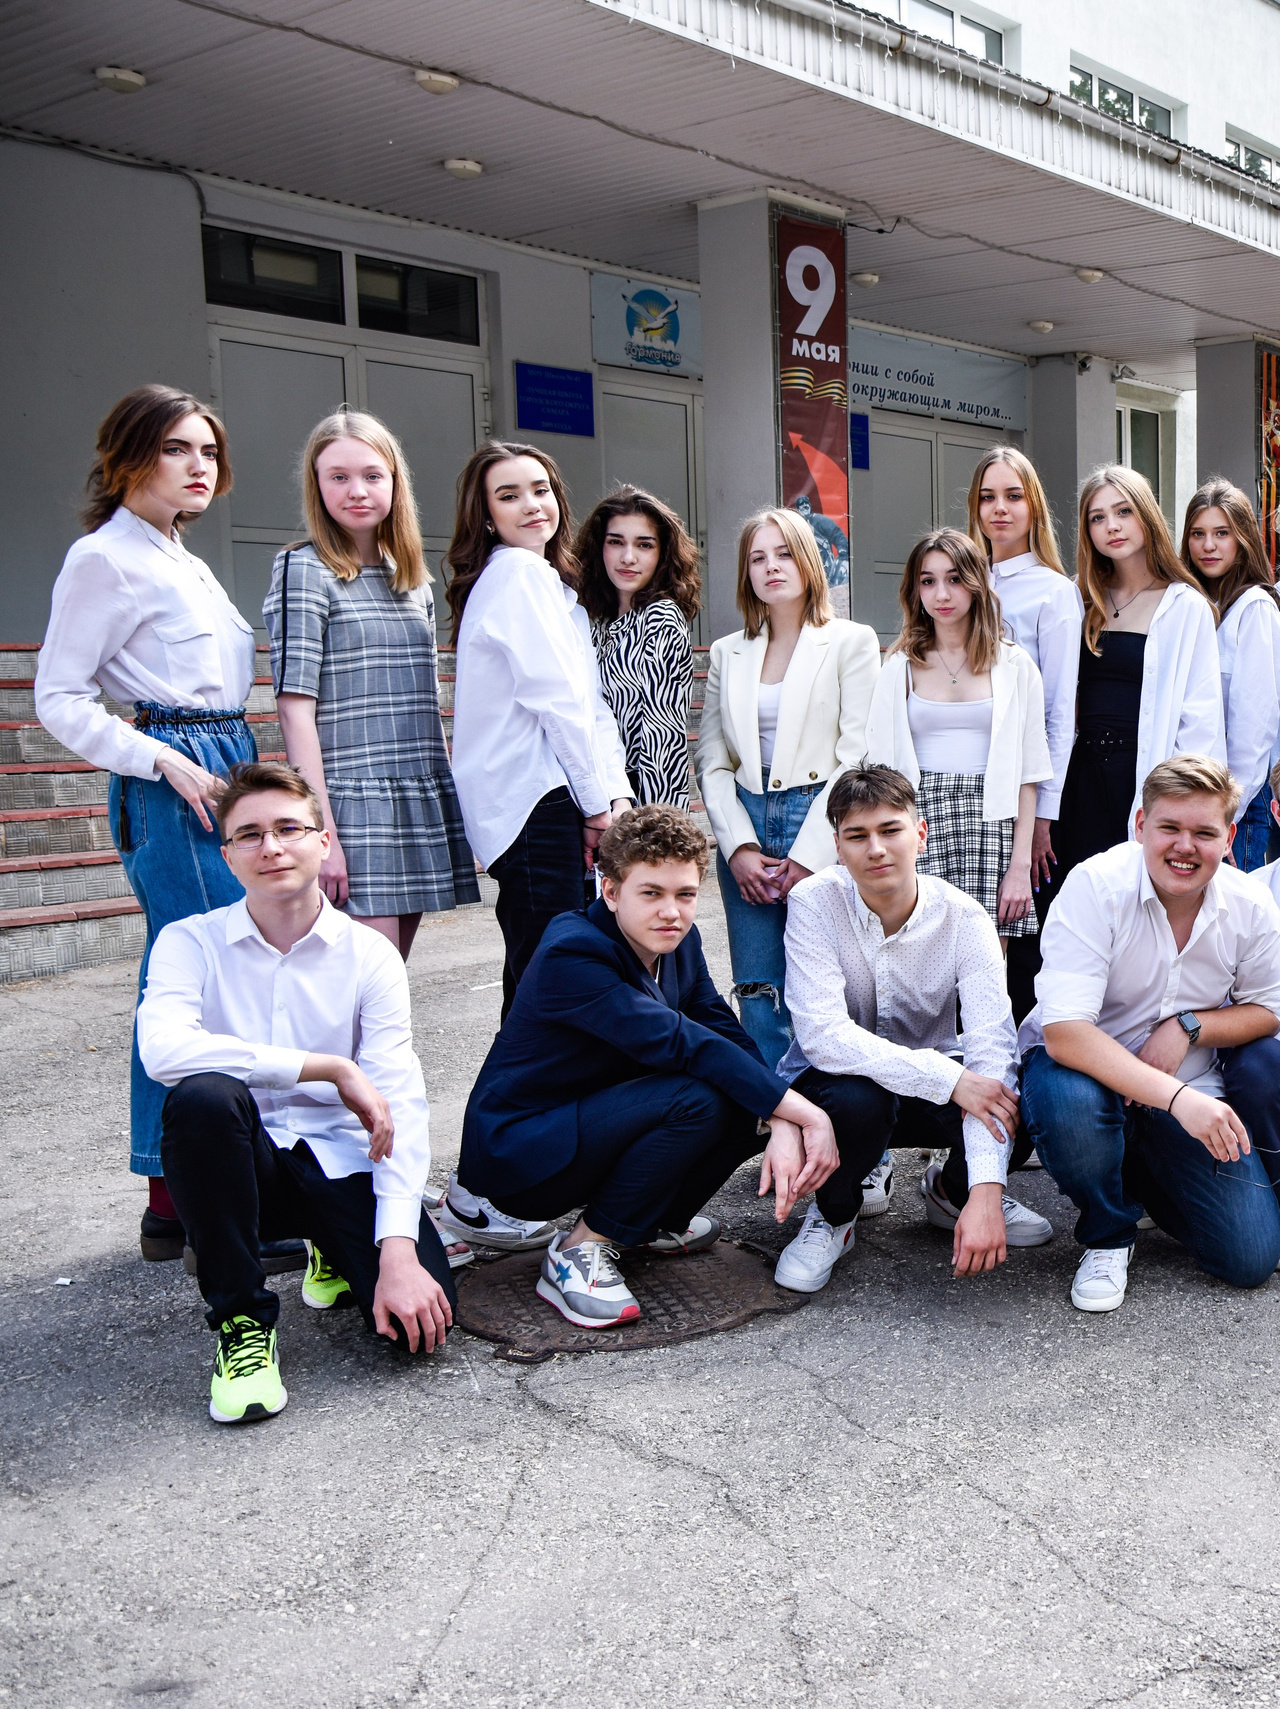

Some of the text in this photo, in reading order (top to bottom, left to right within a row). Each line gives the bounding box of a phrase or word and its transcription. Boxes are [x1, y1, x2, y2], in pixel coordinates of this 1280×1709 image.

[785, 245, 836, 337] 9
[791, 338, 840, 363] мая
[885, 368, 891, 379] с
[897, 369, 935, 387] собой
[557, 390, 583, 400] ШКОЛА
[565, 401, 590, 410] ОКРУГА
[852, 382, 1012, 420] окружающим миром...
